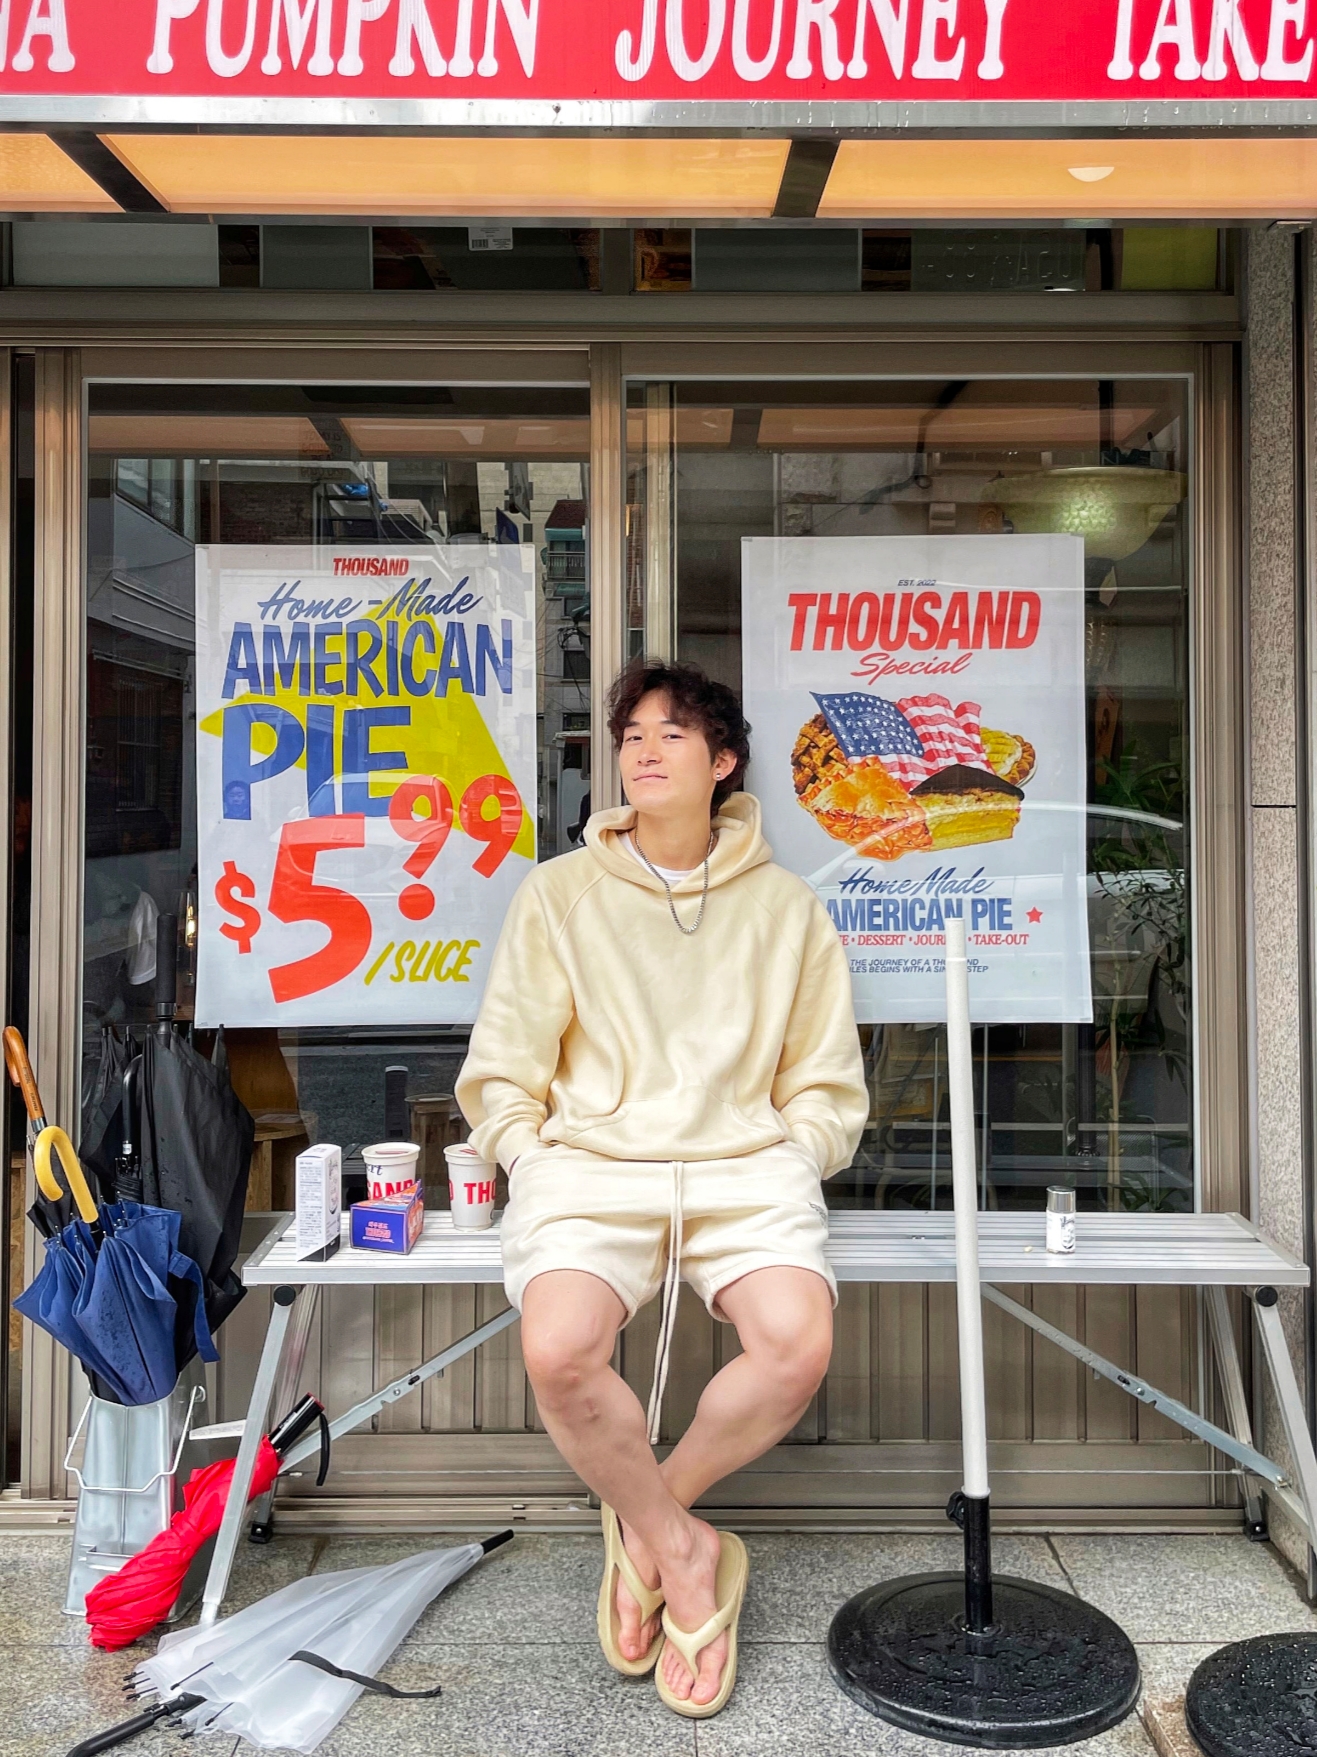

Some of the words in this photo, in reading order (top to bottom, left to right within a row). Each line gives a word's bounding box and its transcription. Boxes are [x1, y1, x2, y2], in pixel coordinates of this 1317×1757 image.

[146, 0, 540, 78] PUMPKIN
[615, 0, 1004, 82] JOURNEY
[333, 557, 409, 576] THOUSAND
[897, 579, 915, 587] EST.
[788, 590, 1042, 652] THOUSAND
[221, 618, 513, 699] AMERICAN
[850, 651, 973, 686] Special
[222, 703, 412, 821] PIE
[825, 897, 963, 932] AMERICAN
[971, 897, 1014, 931] PIE
[857, 934, 906, 946] DESSERT
[973, 933, 1030, 946] TAKE-OUT
[850, 958, 868, 966] THE
[868, 958, 909, 966] JOURNEY
[910, 958, 923, 966] OF
[923, 958, 930, 966] A
[902, 965, 924, 973] WITH
[925, 965, 932, 973] A
